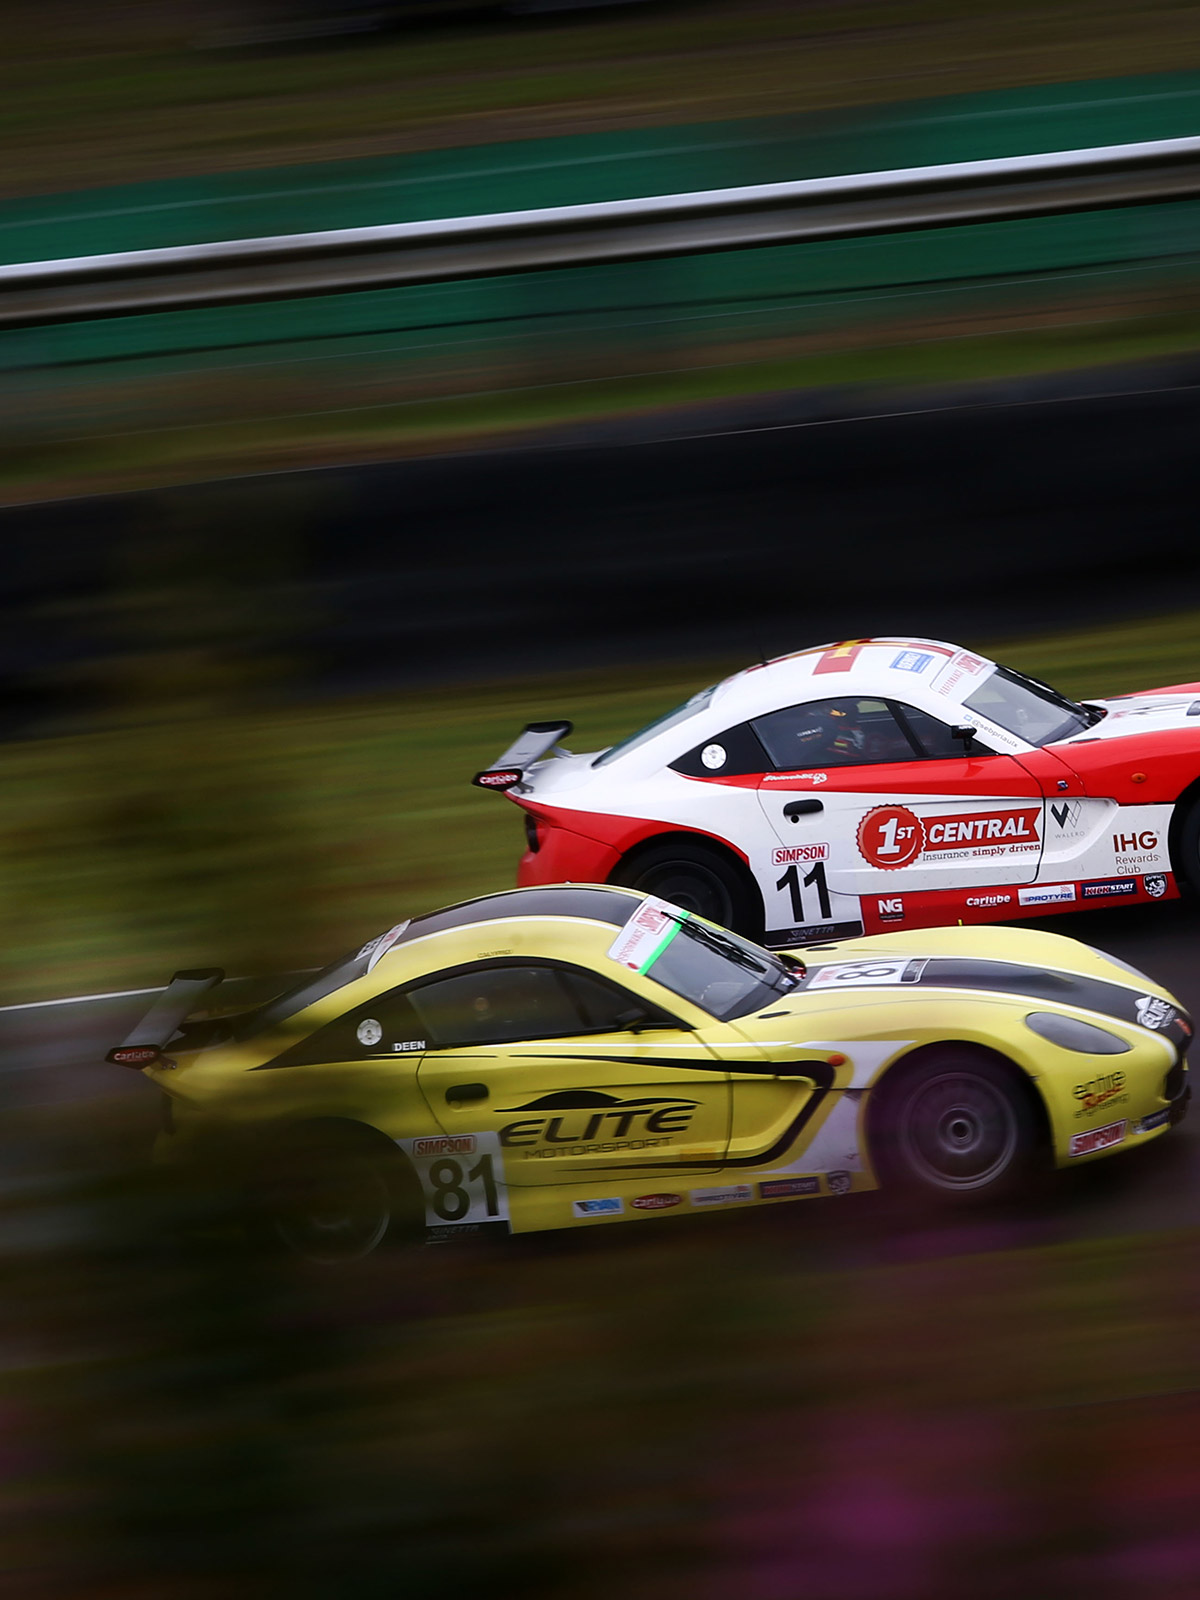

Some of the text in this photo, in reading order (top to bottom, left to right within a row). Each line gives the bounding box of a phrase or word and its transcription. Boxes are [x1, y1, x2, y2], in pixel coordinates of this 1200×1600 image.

[929, 817, 1030, 843] CENTRAL
[1054, 831, 1085, 839] WALERO
[1113, 831, 1157, 853] IHG
[775, 845, 825, 863] SIMPSON
[923, 843, 1041, 861] Insurance simply driven
[1115, 853, 1159, 865] Rewards
[1116, 865, 1141, 875] Club
[776, 862, 832, 923] 11
[1028, 892, 1073, 902] PROTYRE
[878, 898, 903, 914] NG
[791, 925, 835, 937] GINETTA
[394, 1040, 426, 1051] DEEN
[498, 1105, 698, 1147] ELITE
[416, 1138, 472, 1156] SIMPSON
[524, 1137, 674, 1159] MOTORSPORT
[429, 1153, 499, 1221] 81
